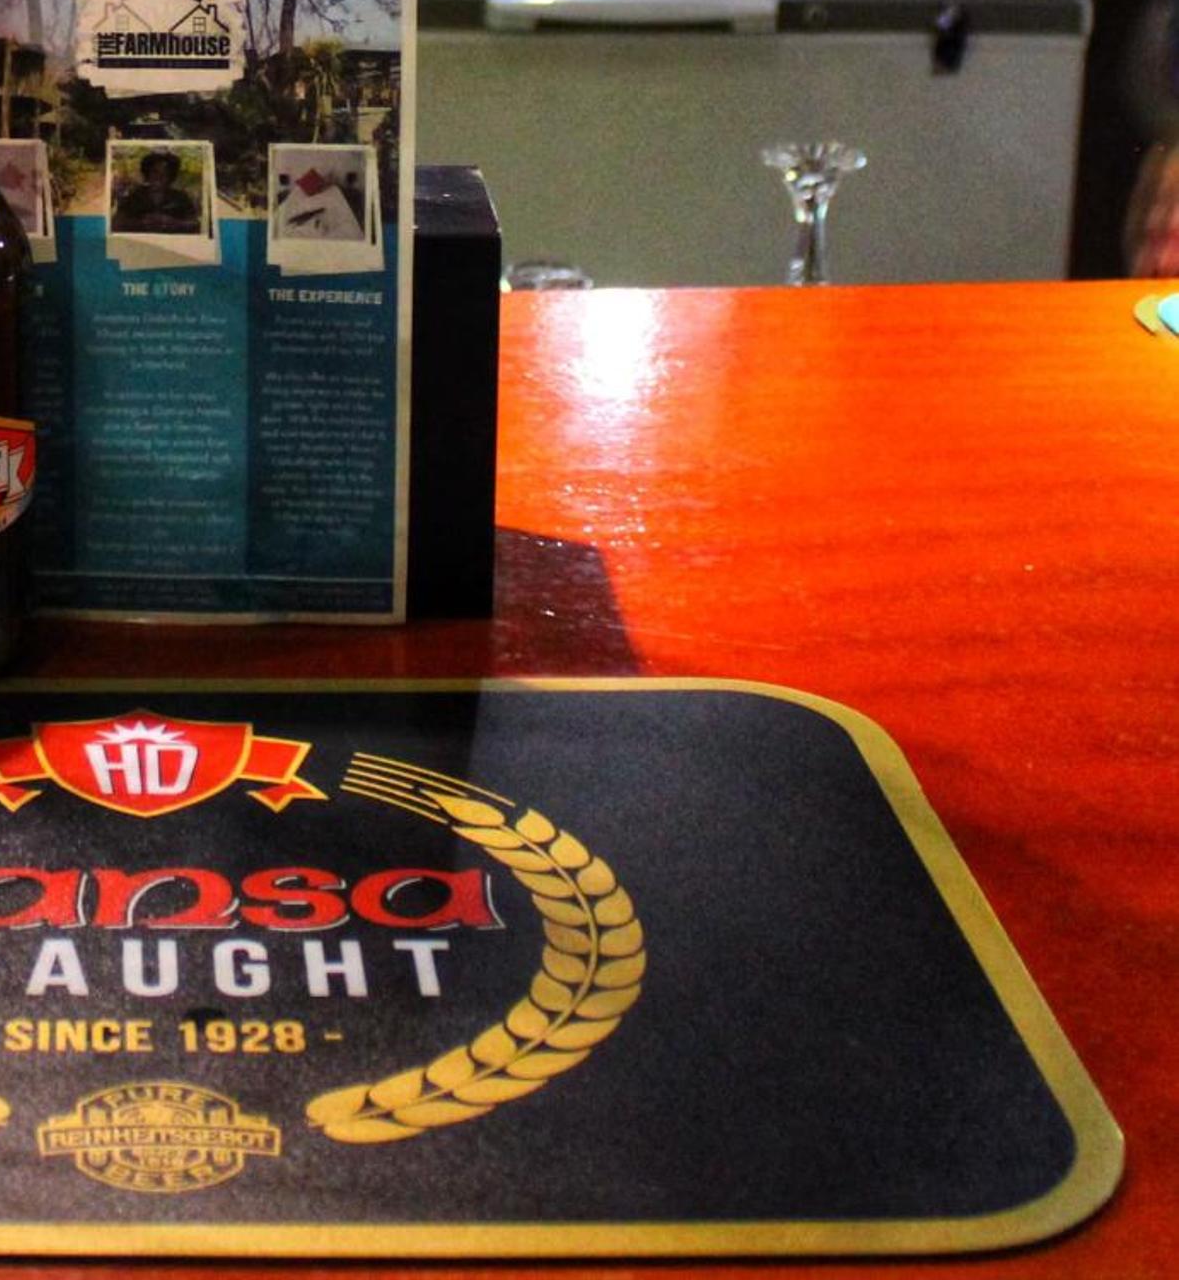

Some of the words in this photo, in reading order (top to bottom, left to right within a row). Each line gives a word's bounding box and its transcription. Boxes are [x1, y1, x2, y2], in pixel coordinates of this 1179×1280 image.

[116, 32, 231, 56] FARMhouse
[122, 282, 148, 296] THE
[268, 288, 297, 302] THE
[84, 740, 199, 797] HD
[4, 1018, 153, 1054] SINCE
[178, 1018, 308, 1054] 1928
[104, 1085, 216, 1109] PURE
[105, 1164, 217, 1190] BEER
